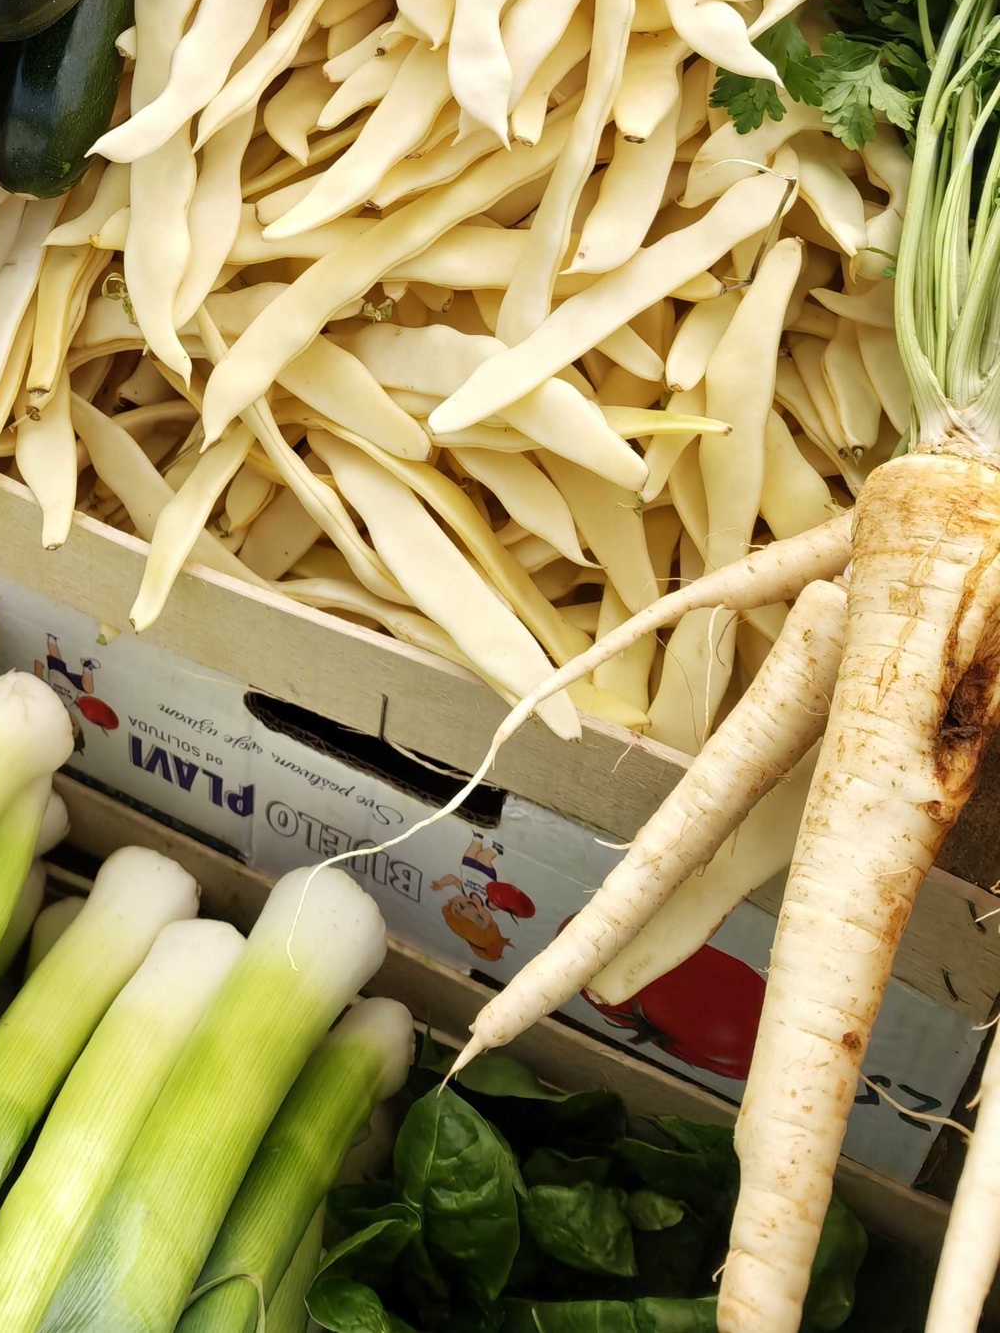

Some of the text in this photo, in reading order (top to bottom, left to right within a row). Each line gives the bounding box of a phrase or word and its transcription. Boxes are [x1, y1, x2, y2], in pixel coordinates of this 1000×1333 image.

[127, 715, 223, 765] od SOLITUDA
[128, 732, 423, 902] BIJELO PLAVI
